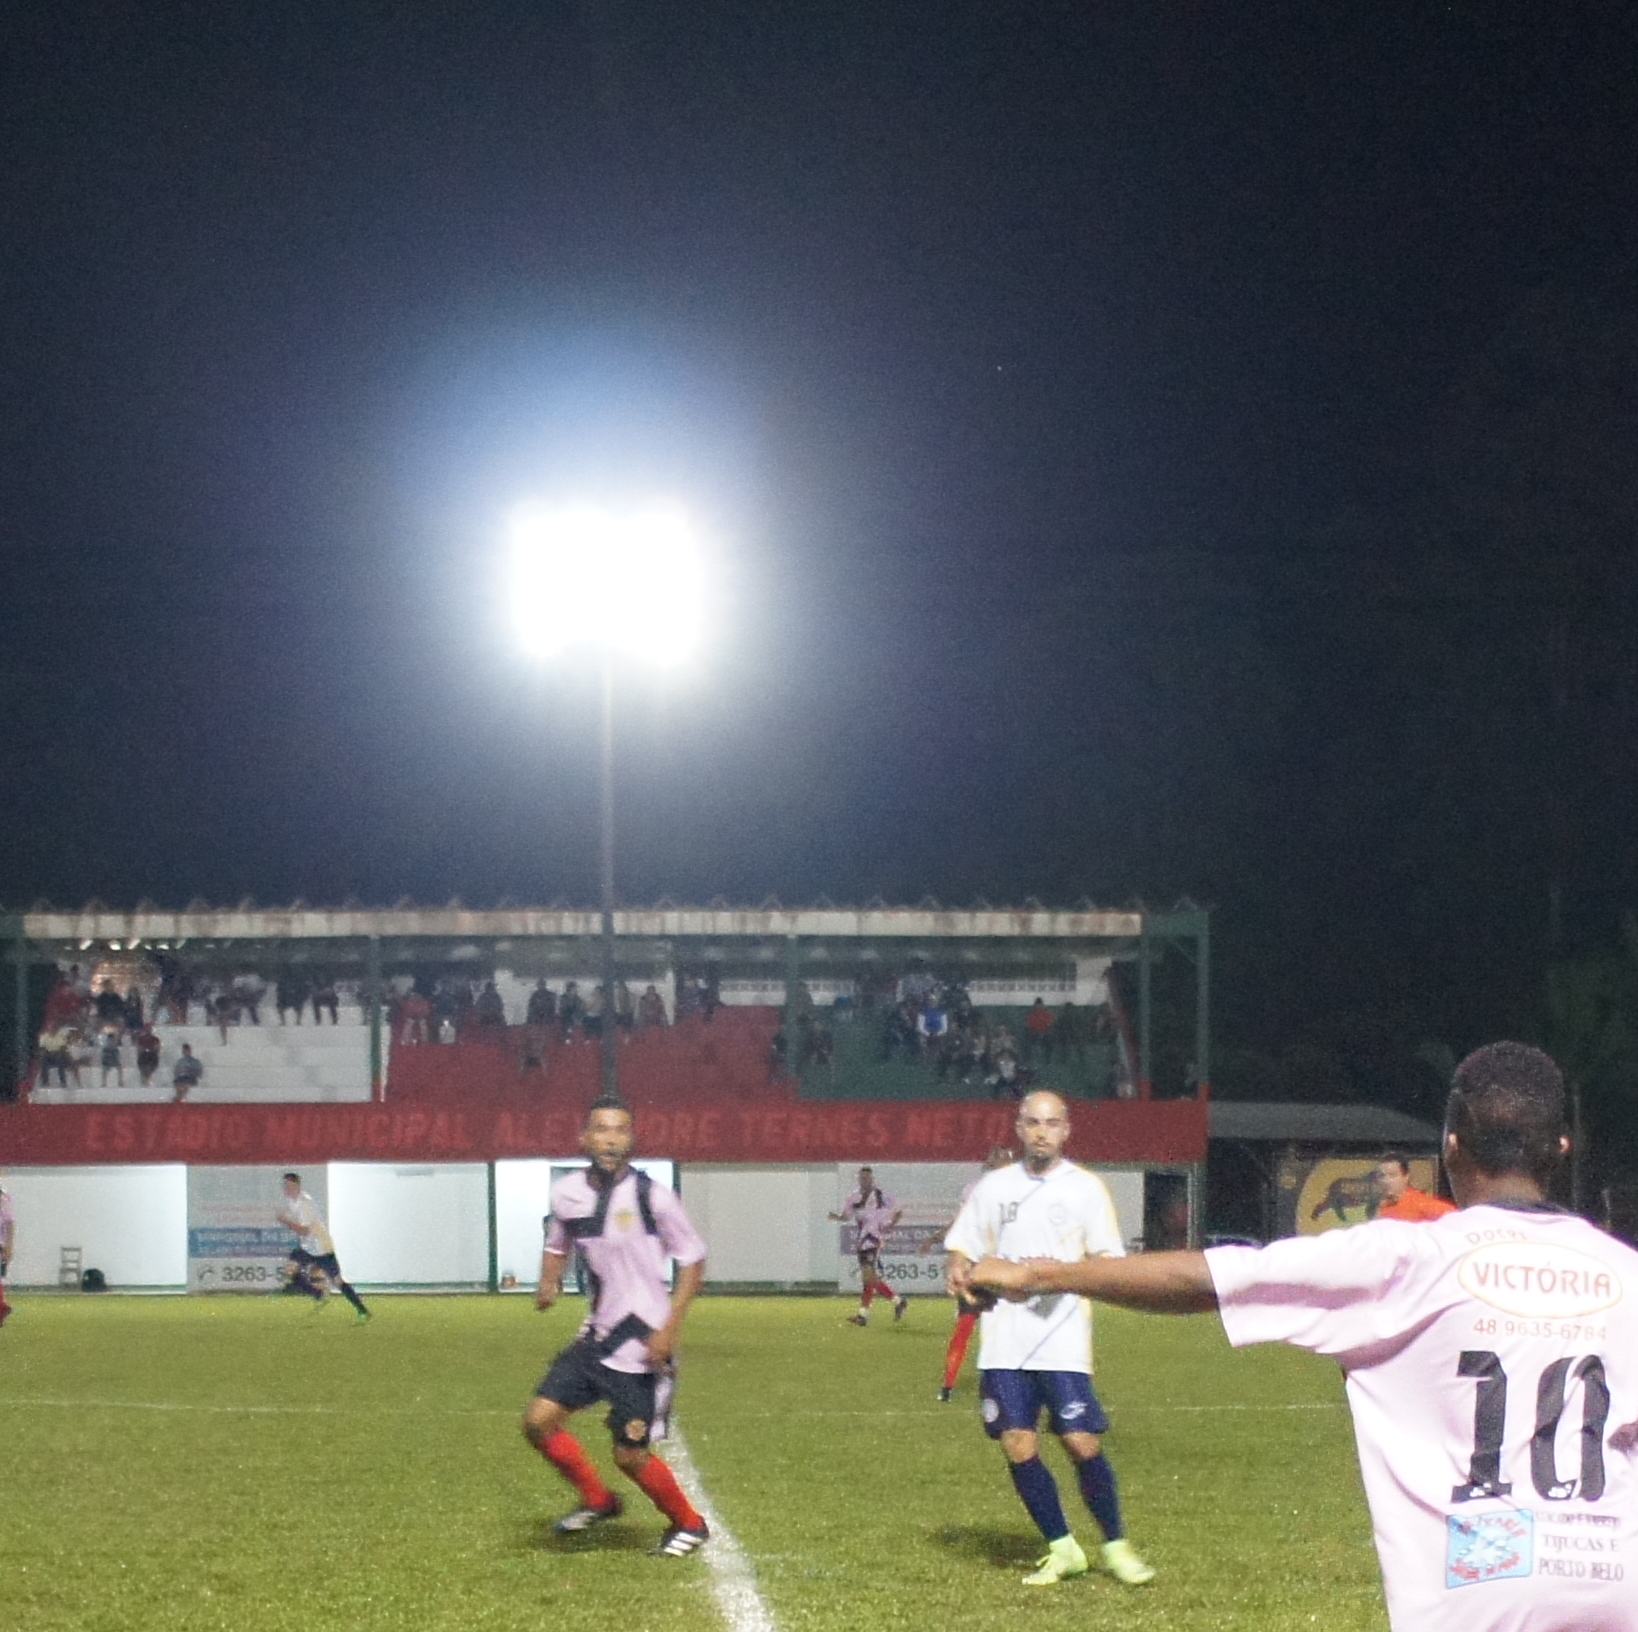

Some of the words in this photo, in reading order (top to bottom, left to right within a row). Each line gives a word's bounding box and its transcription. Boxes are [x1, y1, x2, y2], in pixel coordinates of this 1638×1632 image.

[263, 1110, 472, 1150] MUNICIPAL
[221, 1266, 285, 1281] 3263-5
[1472, 1260, 1611, 1297] VICTÓRIA
[1473, 1318, 1496, 1335] 48
[1450, 1350, 1610, 1504] 10
[1543, 1534, 1603, 1552] TIJUCAS
[1611, 1539, 1619, 1551] E
[1538, 1559, 1586, 1578] PORTO
